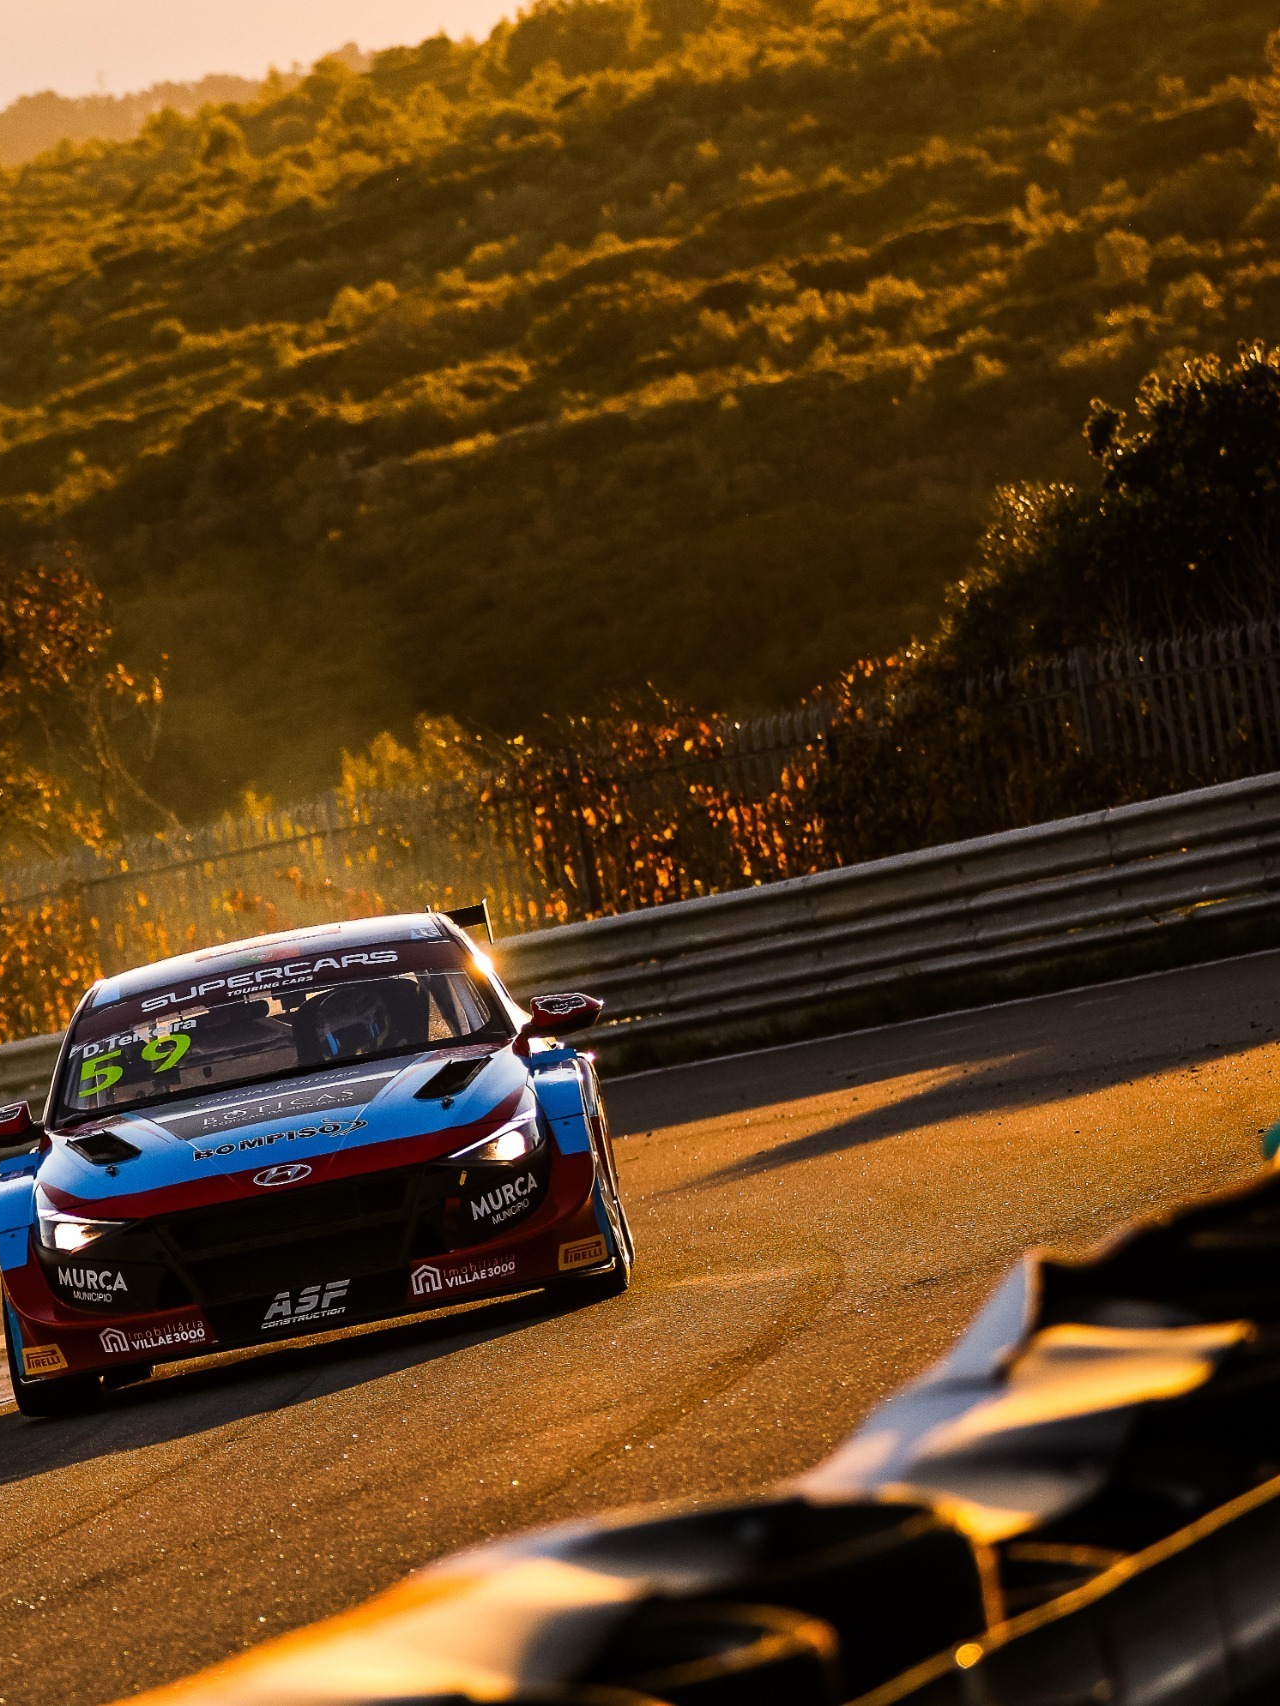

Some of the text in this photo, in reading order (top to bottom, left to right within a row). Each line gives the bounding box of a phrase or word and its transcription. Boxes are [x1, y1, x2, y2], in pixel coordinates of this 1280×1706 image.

[140, 950, 398, 1013] SUPERCARS
[226, 974, 314, 997] TOURING CARS
[203, 1088, 355, 1126] BOTICAS
[193, 1122, 343, 1162] BOMPISO
[563, 1240, 603, 1264] PIRELLI
[263, 1278, 351, 1321] ASF
[260, 1306, 346, 1330] CONSTRUCTION
[25, 1350, 61, 1369] PIRELLI
